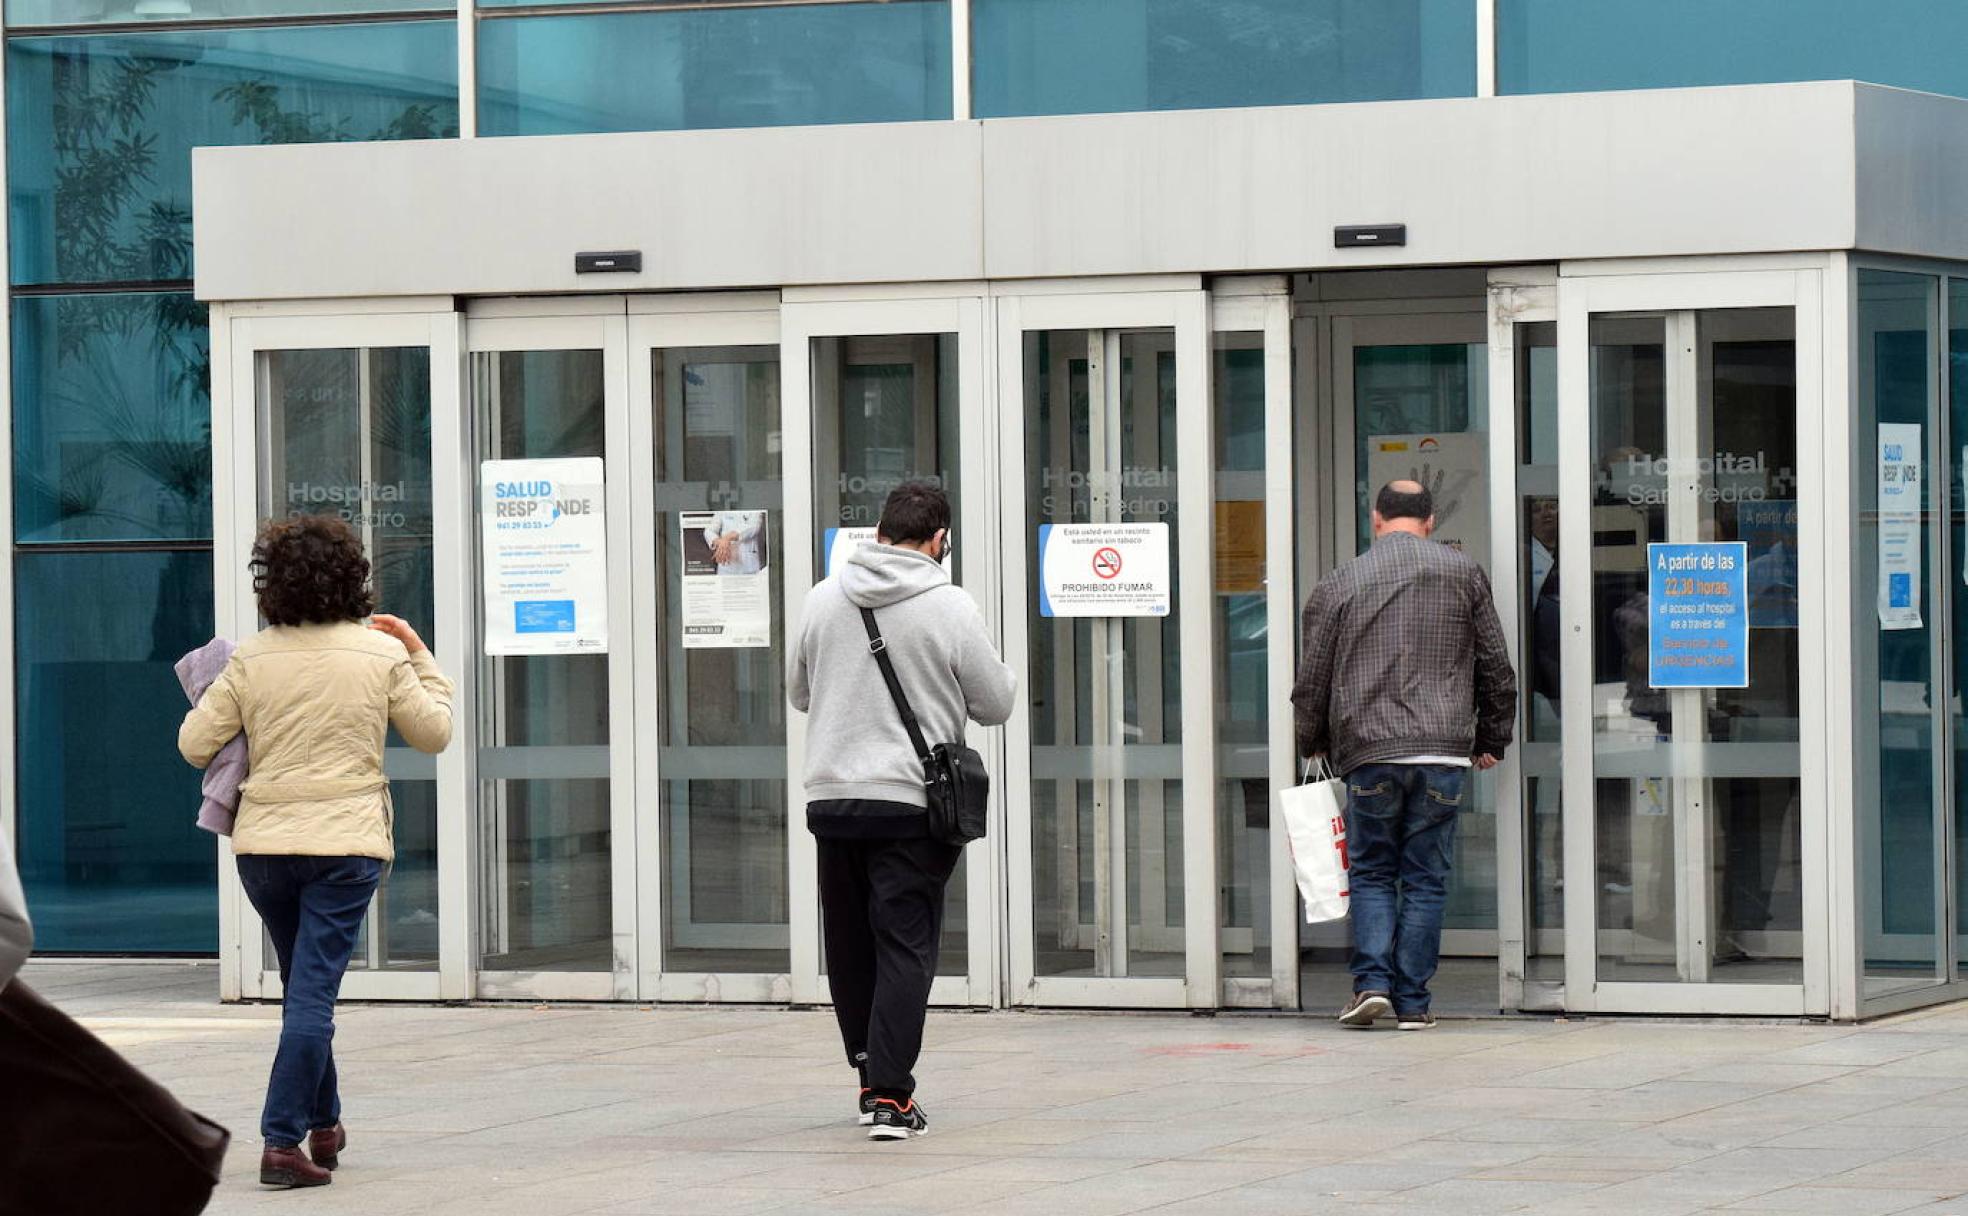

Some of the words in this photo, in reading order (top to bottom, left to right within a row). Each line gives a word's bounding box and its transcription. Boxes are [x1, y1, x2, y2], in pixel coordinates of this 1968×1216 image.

[1628, 450, 1765, 478] Hopital
[1043, 465, 1169, 491] Hoital
[288, 480, 405, 508] Hospital
[495, 481, 552, 498] SALUD
[835, 504, 869, 521] an
[1043, 496, 1087, 516] Sn
[1100, 494, 1170, 515] edro
[1081, 528, 1101, 536] usted
[1657, 553, 1667, 570] A
[1668, 552, 1698, 574] partir
[1701, 552, 1716, 570] de
[1718, 552, 1735, 570] las
[1062, 583, 1116, 592] PROHIBIDO
[1118, 583, 1153, 592] FUMAR
